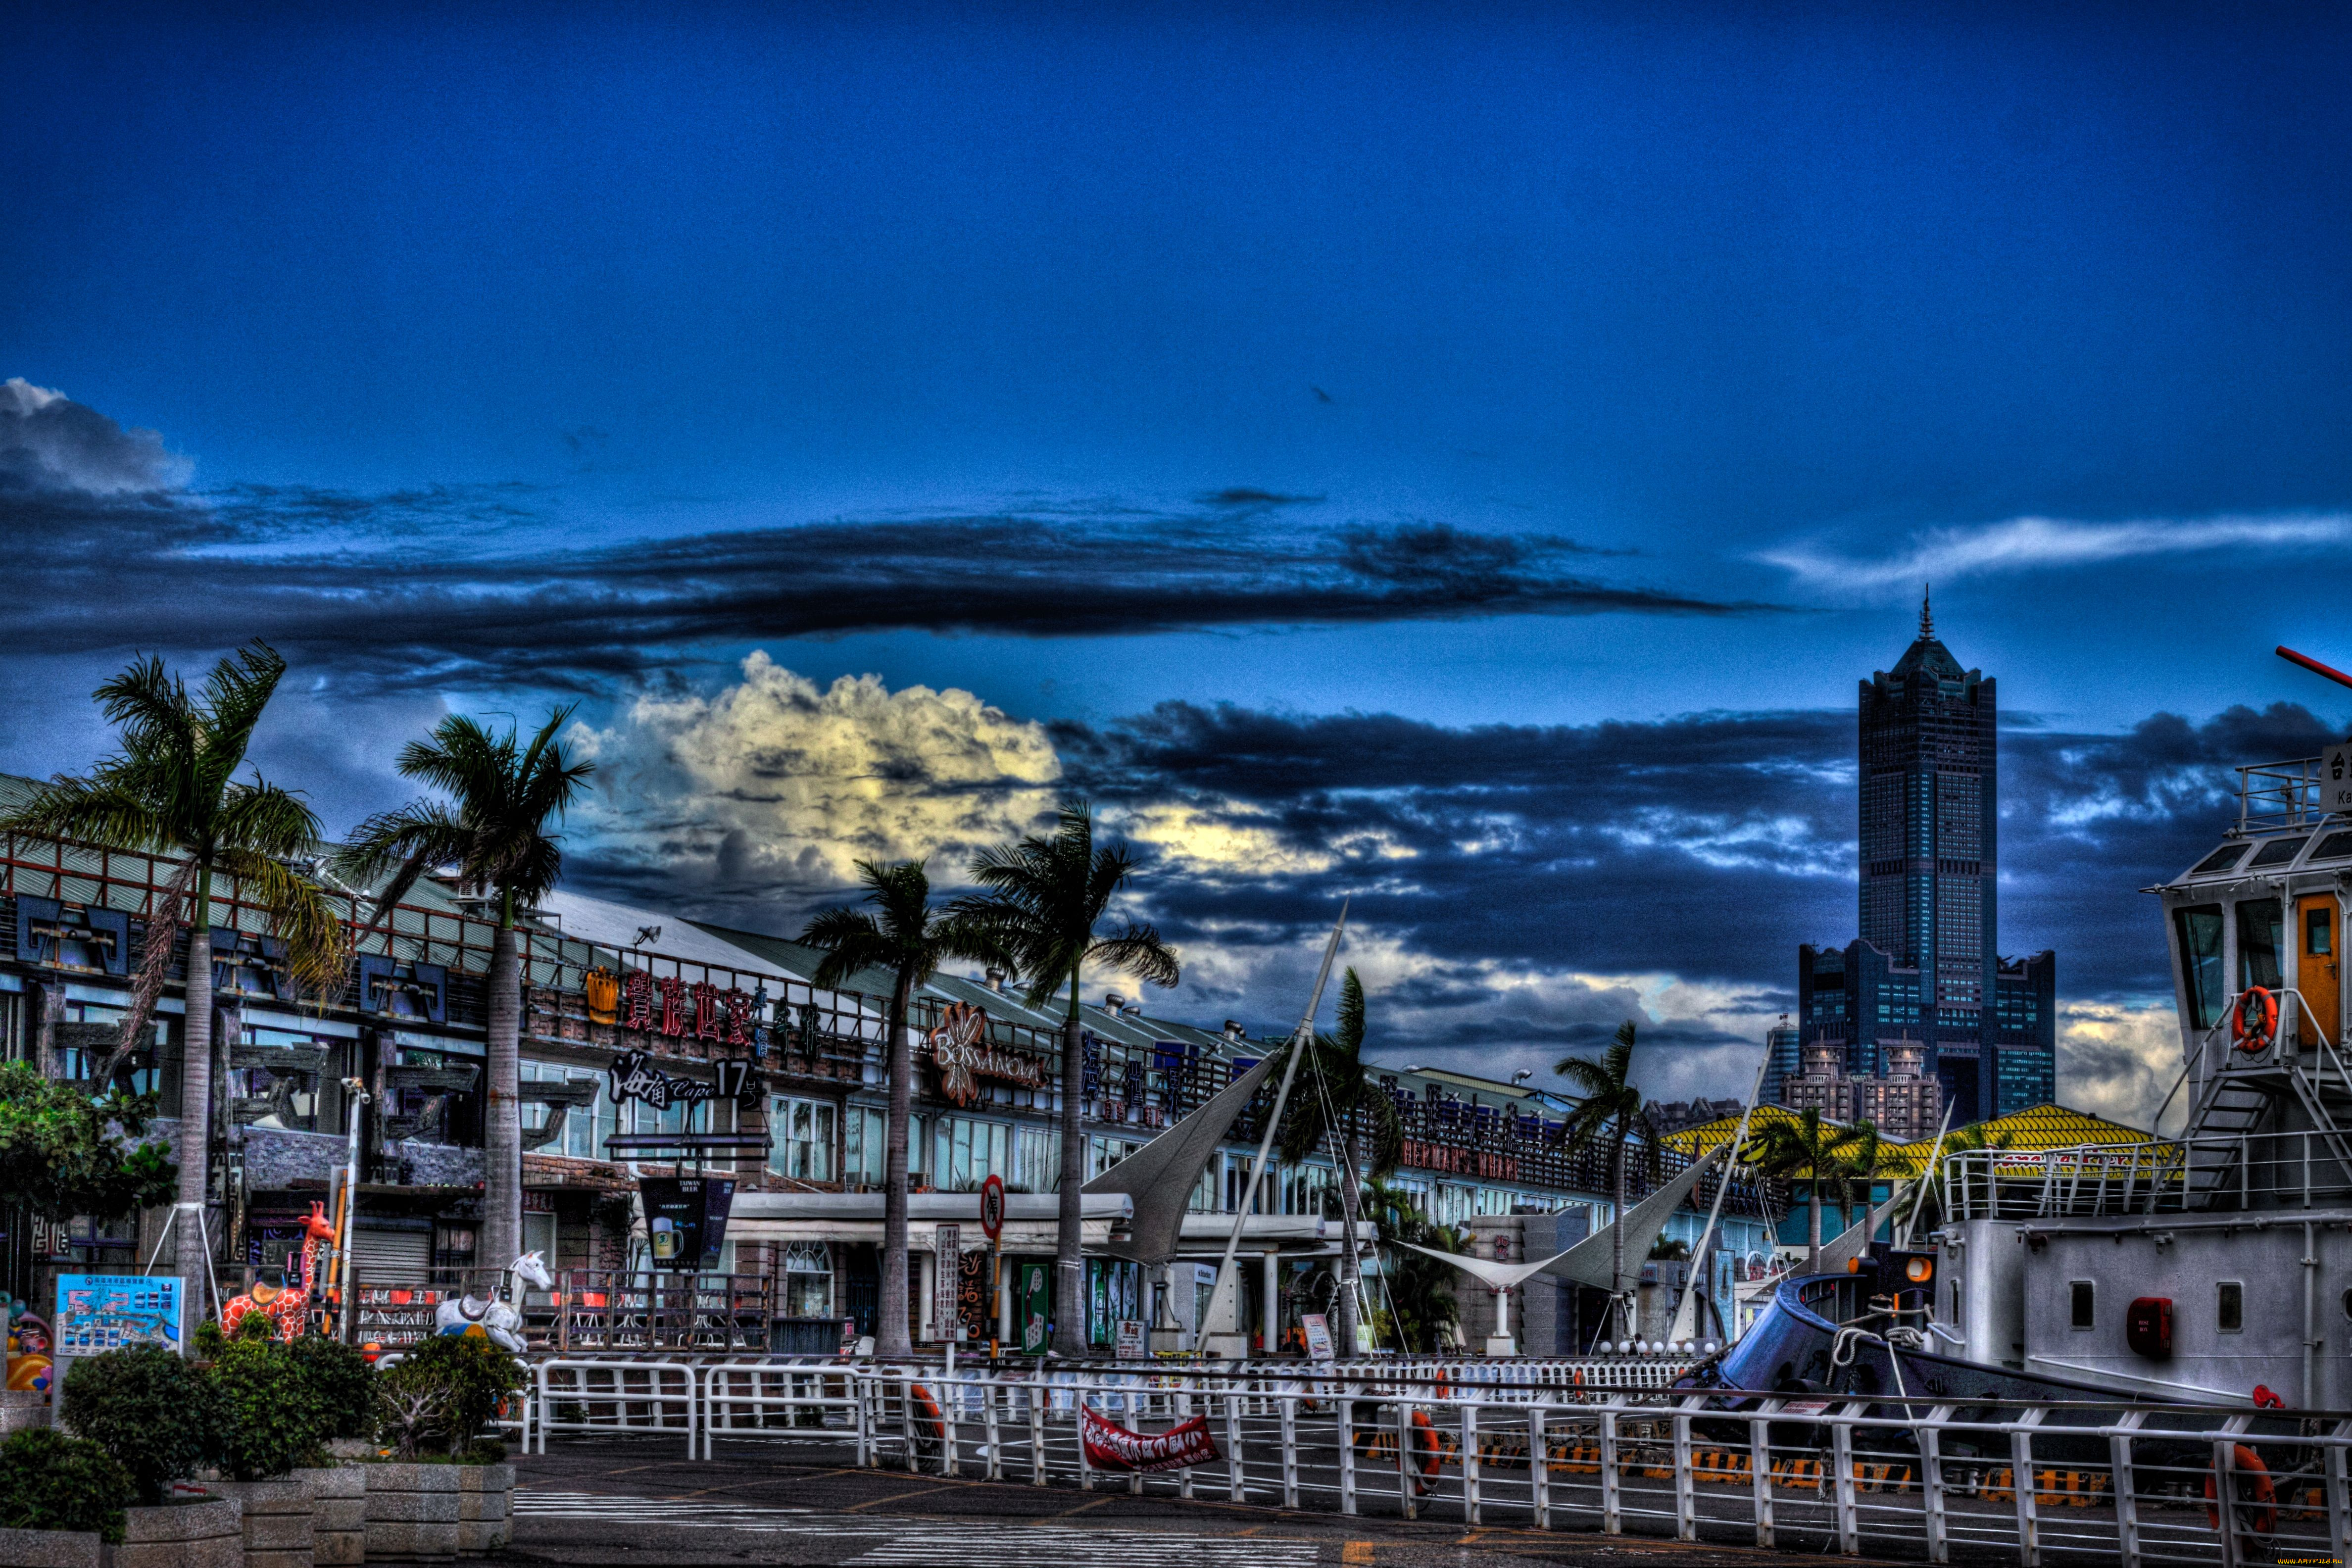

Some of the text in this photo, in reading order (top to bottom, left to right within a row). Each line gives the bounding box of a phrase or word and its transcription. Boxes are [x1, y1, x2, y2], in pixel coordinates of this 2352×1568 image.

[2331, 751, 2352, 780] 台
[627, 969, 750, 1046] 貴族世家
[986, 1193, 998, 1222] 停
